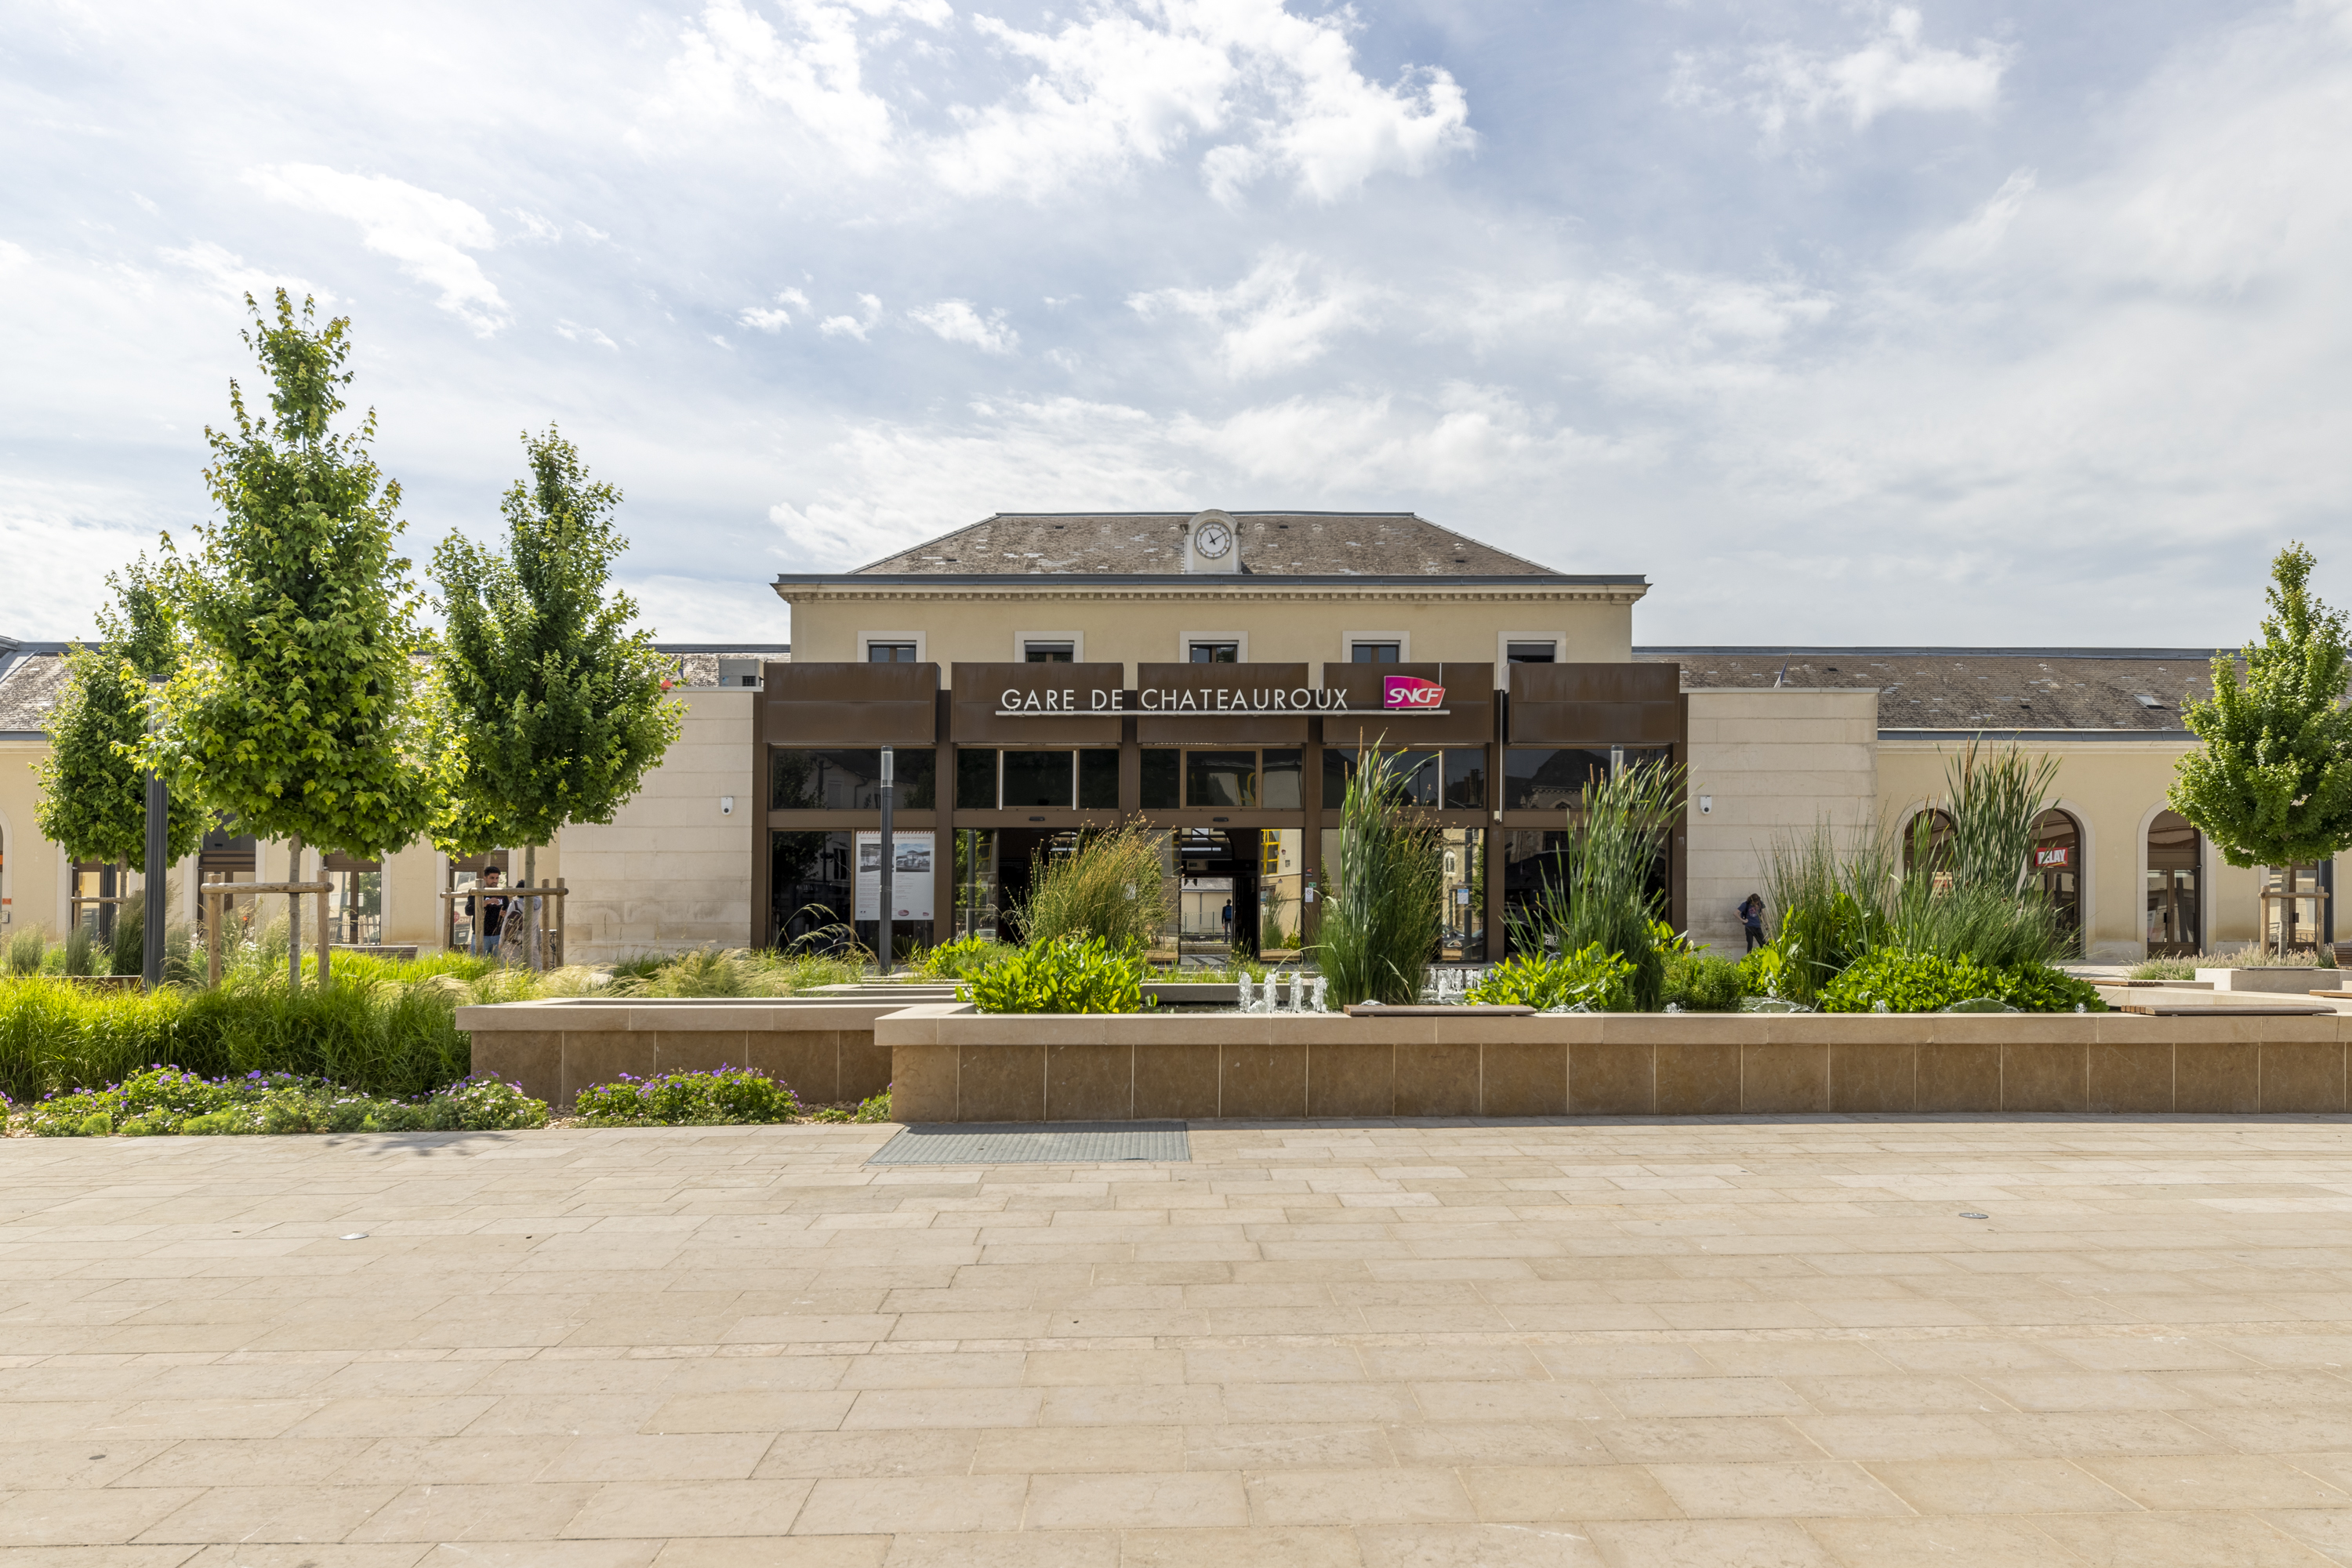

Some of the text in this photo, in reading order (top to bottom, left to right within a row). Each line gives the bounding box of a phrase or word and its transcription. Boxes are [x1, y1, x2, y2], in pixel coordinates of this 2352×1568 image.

[1001, 688, 1348, 710] GARE DE CHATEAUROUX
[1387, 688, 1442, 703] SNCF
